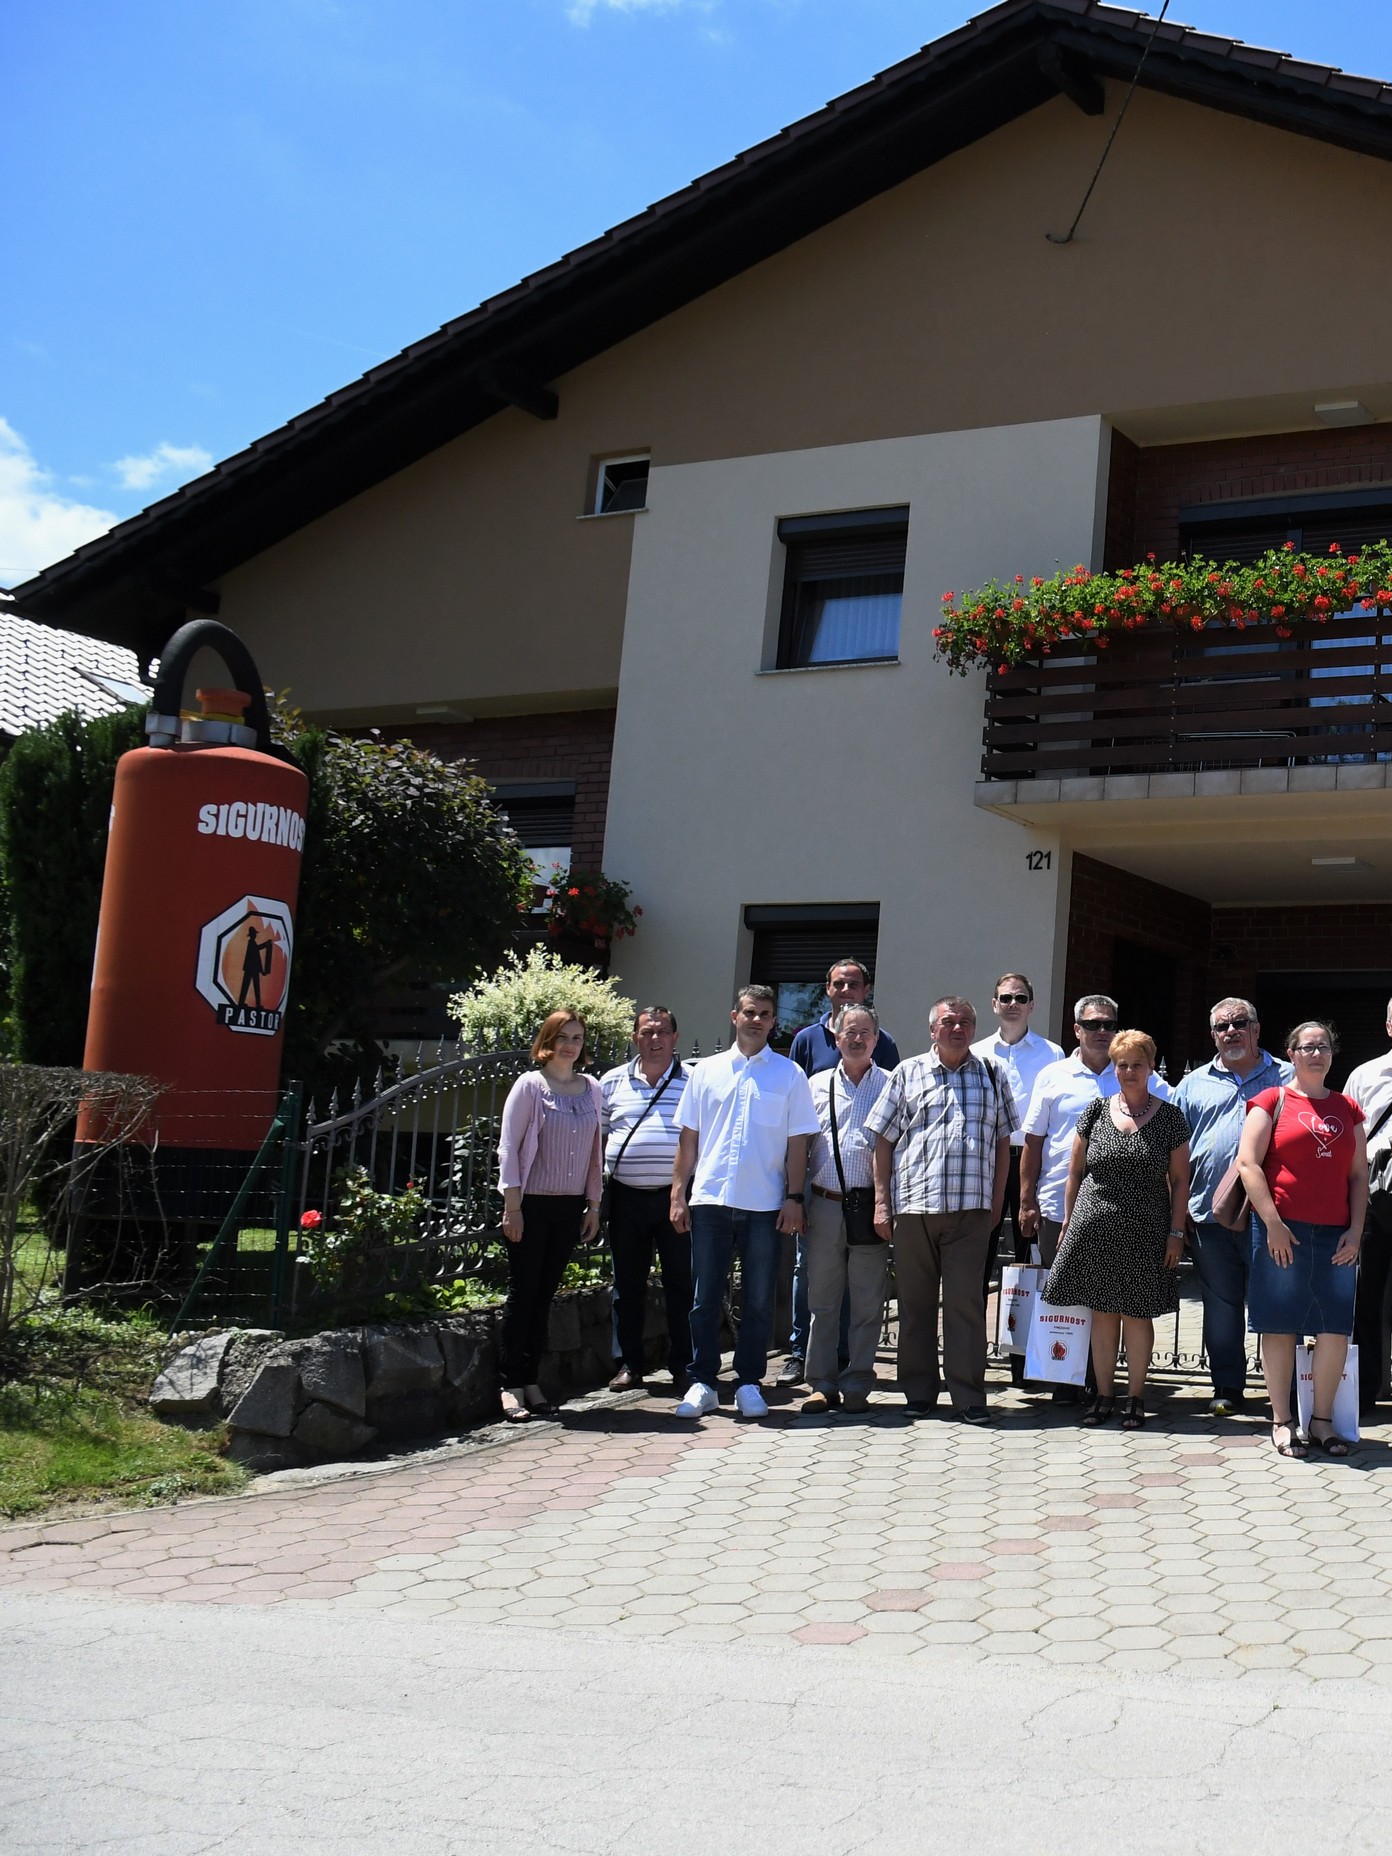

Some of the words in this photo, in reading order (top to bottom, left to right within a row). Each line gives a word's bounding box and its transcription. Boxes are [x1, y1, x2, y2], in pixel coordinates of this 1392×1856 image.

[198, 801, 306, 853] SIGURNOS
[1026, 850, 1051, 870] 121
[225, 1008, 280, 1029] PASTOR
[1003, 1288, 1030, 1297] IGURNOST
[1039, 1315, 1086, 1326] SIGURNOST
